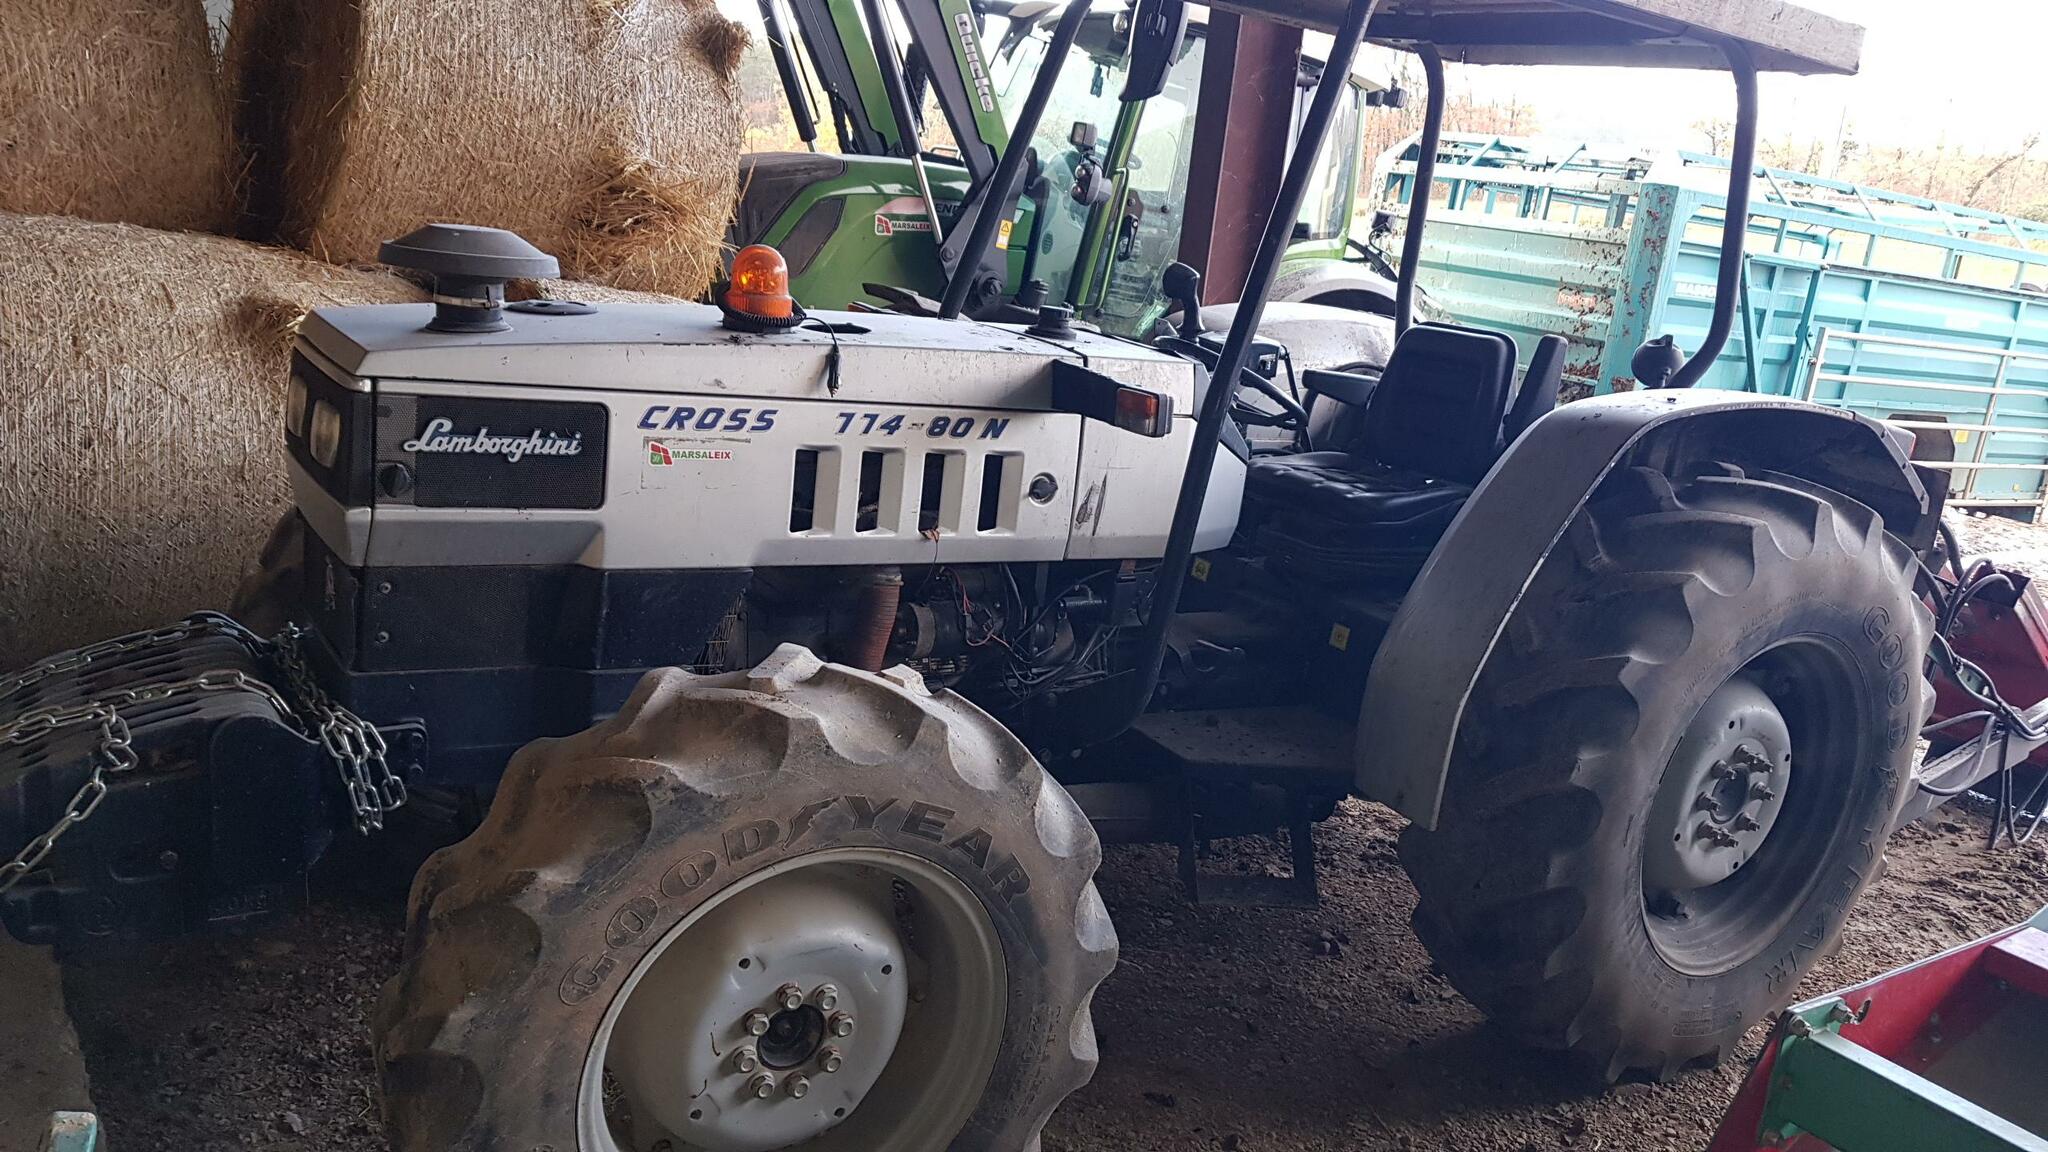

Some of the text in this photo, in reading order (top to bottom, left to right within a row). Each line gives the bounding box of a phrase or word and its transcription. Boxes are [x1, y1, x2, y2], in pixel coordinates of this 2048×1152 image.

[955, 13, 994, 113] Quicke
[891, 220, 931, 231] MARSALEIX
[403, 417, 582, 463] Lamborghini
[637, 405, 779, 432] CROSS
[978, 417, 1010, 440] N
[671, 450, 731, 459] MARSALEIX
[558, 795, 1032, 1006] GOODYEAR
